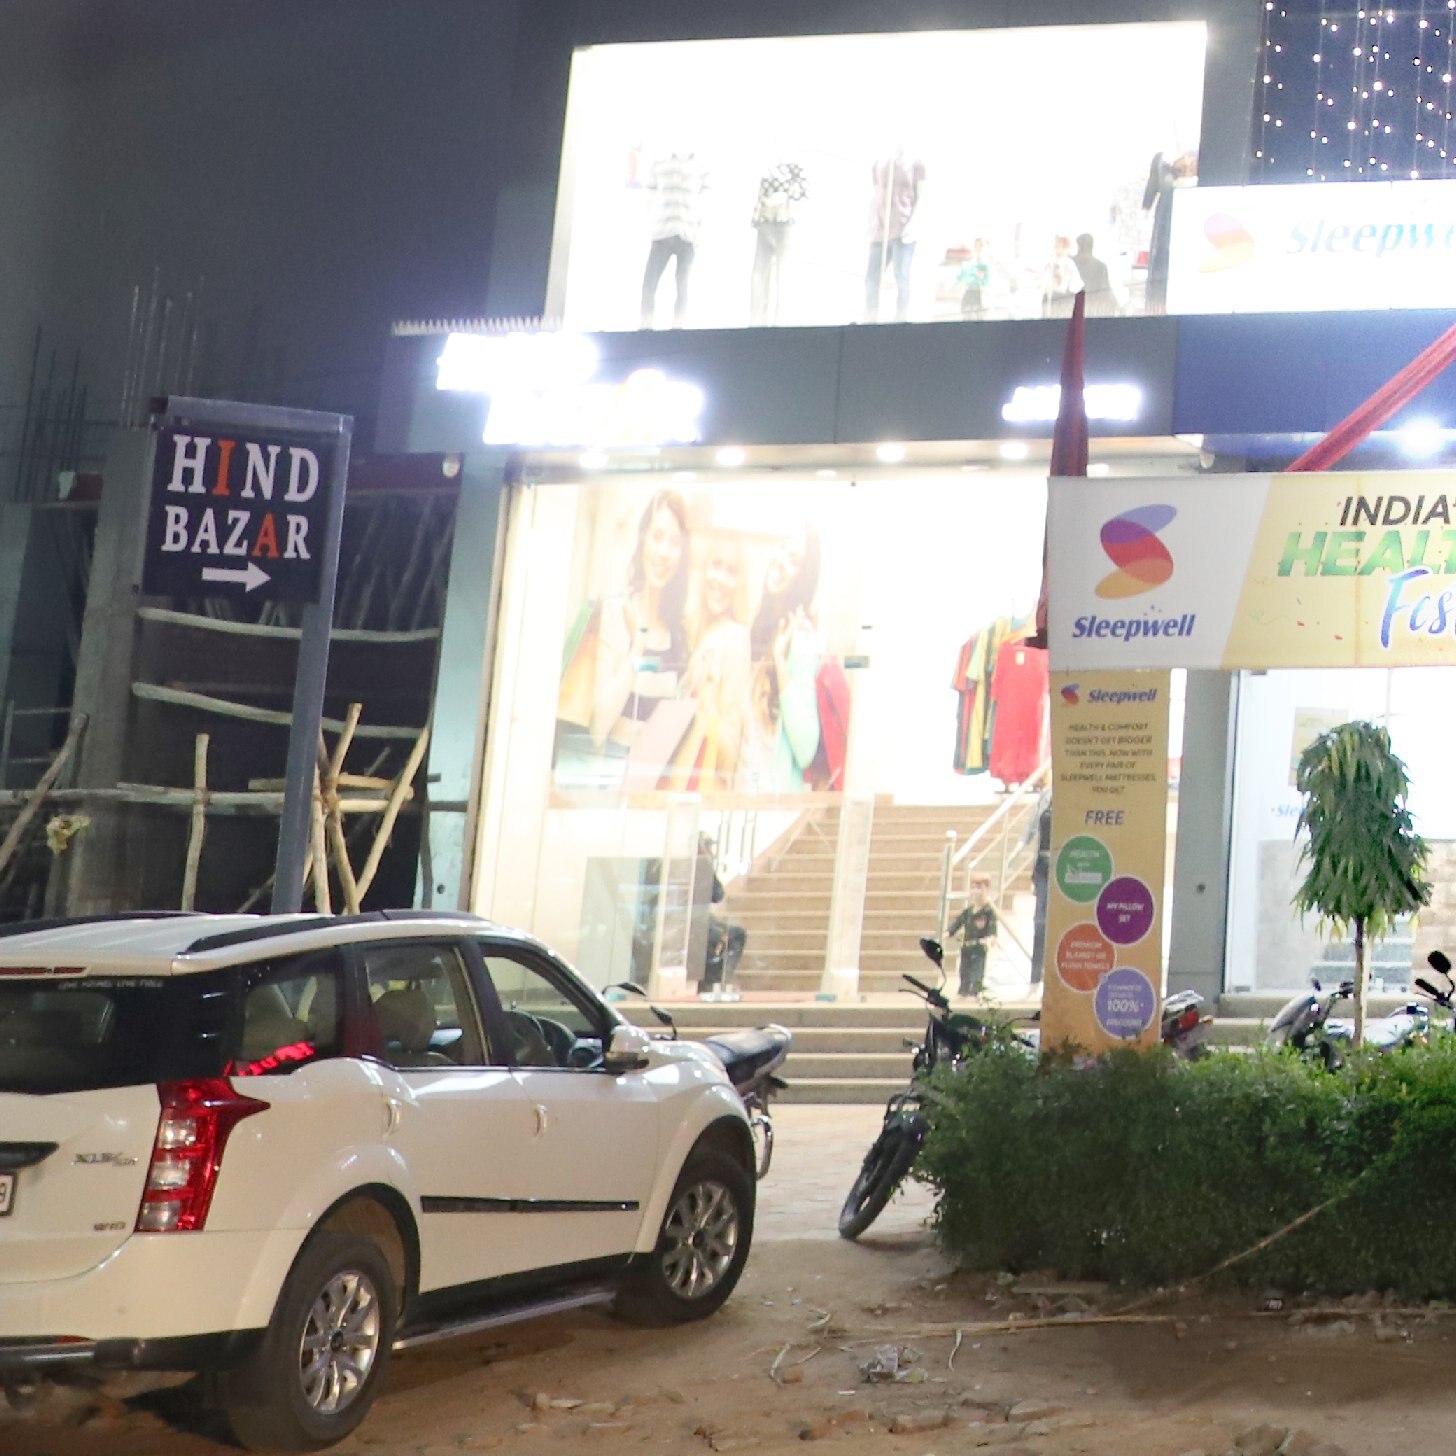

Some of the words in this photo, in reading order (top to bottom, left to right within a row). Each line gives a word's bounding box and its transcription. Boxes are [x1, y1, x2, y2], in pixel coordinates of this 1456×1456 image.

[167, 434, 320, 503] HIND
[160, 505, 311, 559] BAZAR
[1071, 614, 1197, 643] Sleepwell
[1087, 688, 1158, 704] Sleepwell
[1085, 809, 1125, 825] FREE
